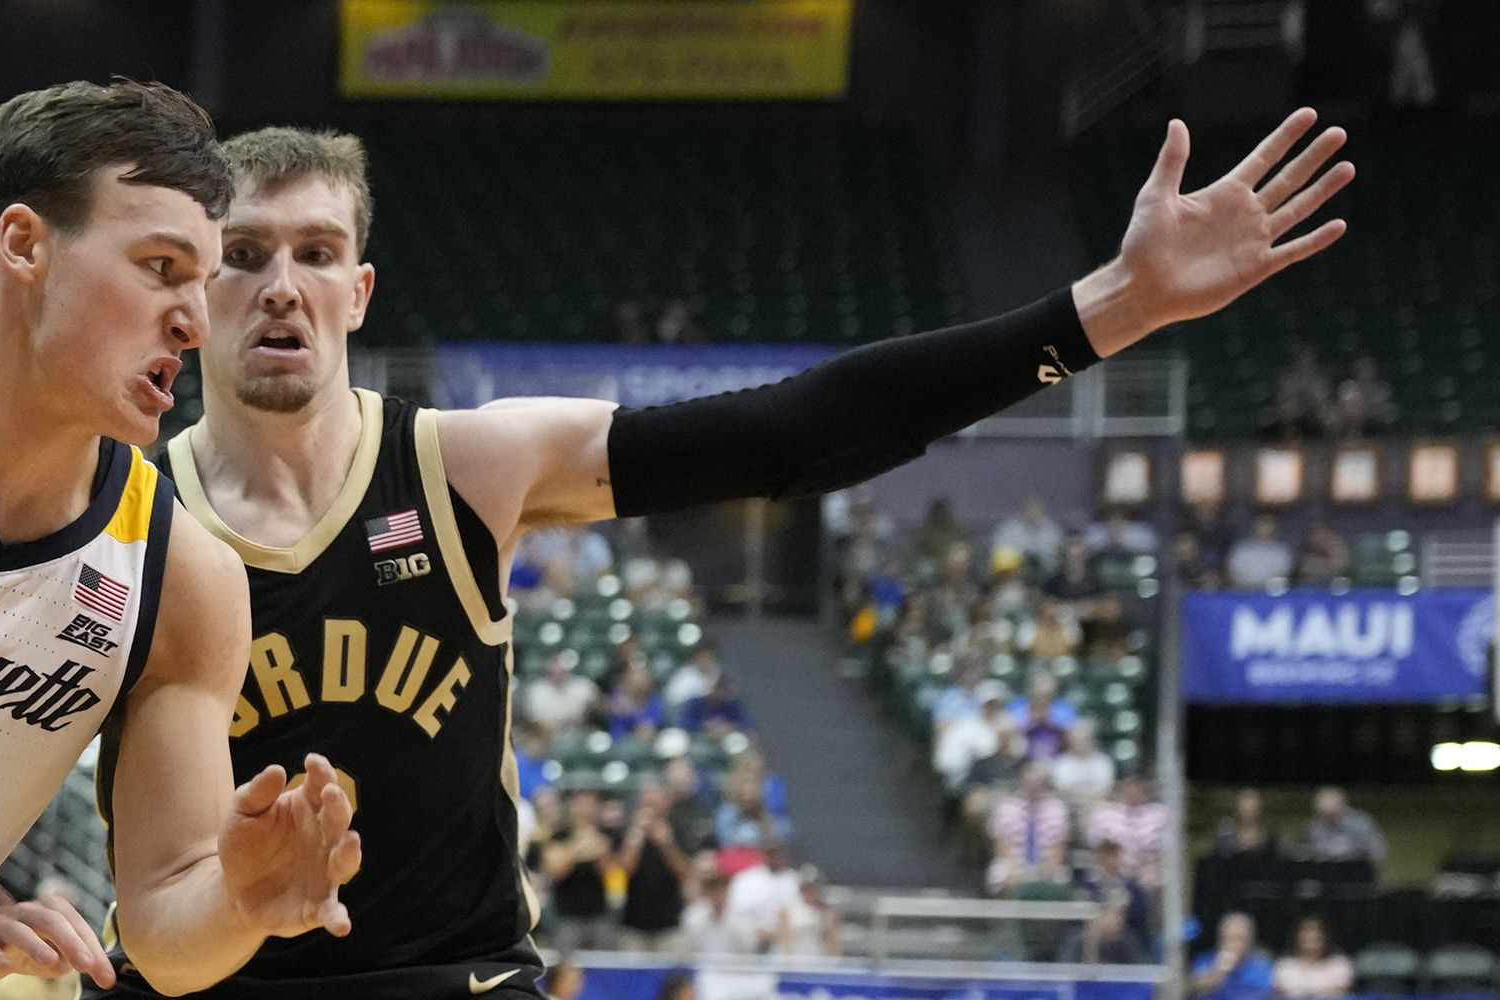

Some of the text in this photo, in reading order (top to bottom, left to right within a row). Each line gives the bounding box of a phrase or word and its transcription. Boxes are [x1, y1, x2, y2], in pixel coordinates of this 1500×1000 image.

[61, 624, 118, 652] EAST
[72, 613, 112, 637] BIG
[1231, 602, 1414, 660] MAUI
